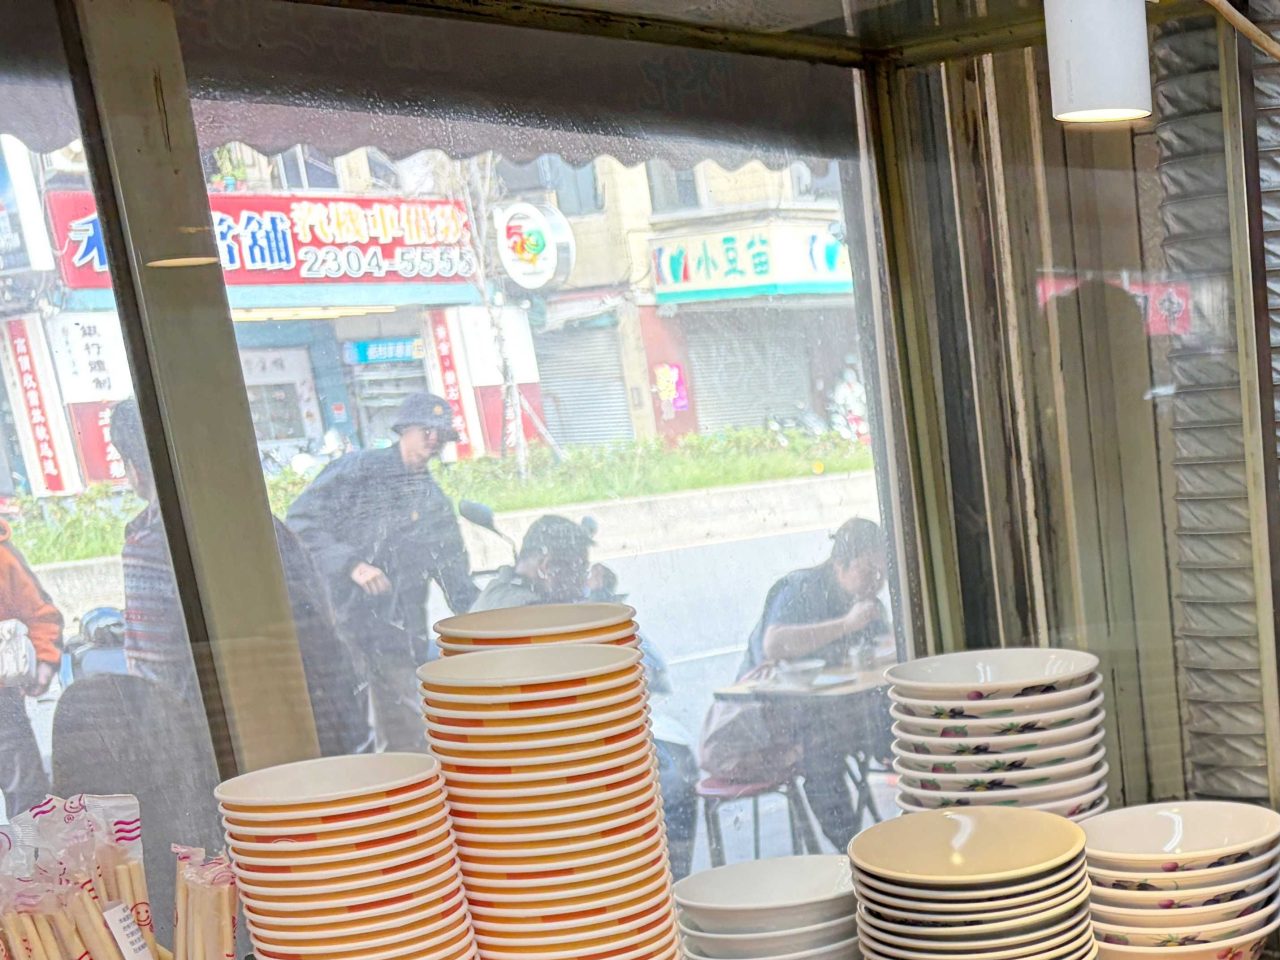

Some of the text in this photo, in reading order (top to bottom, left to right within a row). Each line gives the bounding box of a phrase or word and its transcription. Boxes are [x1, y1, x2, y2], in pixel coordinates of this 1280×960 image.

[298, 245, 477, 278] 2304-5555
[696, 236, 769, 281] 小豆苗
